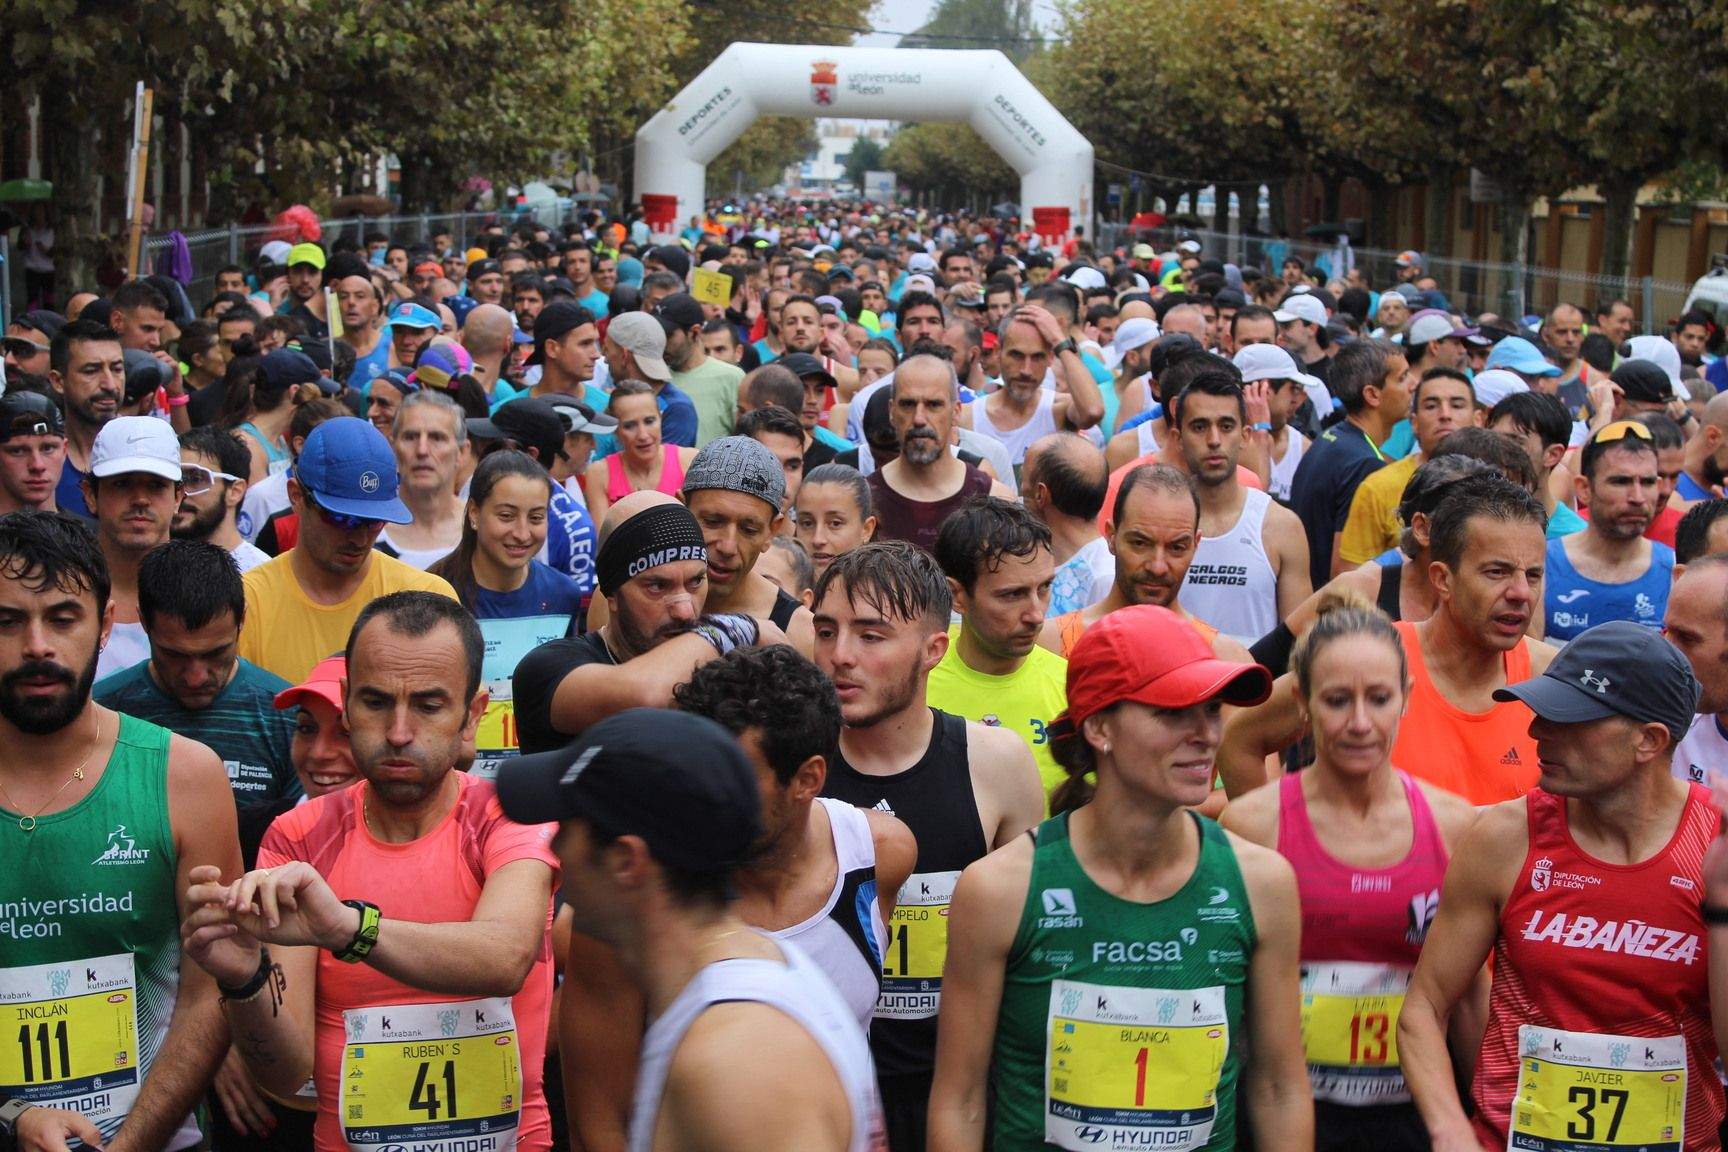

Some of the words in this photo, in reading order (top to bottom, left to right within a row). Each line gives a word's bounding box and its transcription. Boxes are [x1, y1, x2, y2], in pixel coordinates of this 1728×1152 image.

[847, 72, 921, 84] universidad
[678, 87, 731, 135] DEPORTES
[995, 95, 1046, 146] DEPORTES
[706, 281, 721, 298] 45
[363, 476, 378, 489] Buff
[1189, 565, 1247, 575] GALGOS
[1188, 575, 1248, 586] NEGROS
[230, 780, 267, 791] deportes
[104, 849, 150, 860] SPRINT
[1552, 879, 1562, 887] DE
[1562, 880, 1585, 890] LEÓN
[1553, 871, 1601, 885] DIPUTACIÓN
[921, 882, 930, 895] k
[0, 891, 133, 918] niversidad
[921, 894, 952, 902] kutxaba
[889, 909, 929, 921] MPELO
[11, 916, 62, 940] león
[86, 968, 97, 982] k
[87, 978, 129, 990] kutxabank
[0, 992, 32, 1000] txabank
[876, 995, 936, 1008] YUNDAI
[16, 1003, 68, 1021] INCLÁN
[475, 1009, 485, 1023] k
[382, 1015, 391, 1030] k
[475, 1020, 512, 1032] kutxabank
[381, 1029, 423, 1038] kutxabank
[1120, 1029, 1170, 1044] BLANCA
[1350, 1012, 1389, 1066] 13
[17, 1020, 71, 1083] 111
[452, 1043, 461, 1055] S
[1553, 1038, 1562, 1052] k
[1552, 1052, 1592, 1063] kutxabank
[1645, 1047, 1654, 1060] k
[1644, 1058, 1681, 1068] kutxabank
[1135, 1047, 1149, 1106] 1
[1576, 1070, 1623, 1085] JAVIER
[408, 1060, 457, 1120] 41
[83, 1107, 111, 1118] moción
[1567, 1086, 1630, 1142] 37
[1113, 1129, 1194, 1144] HYUNDAI
[413, 1137, 496, 1152] HYUNDAI
